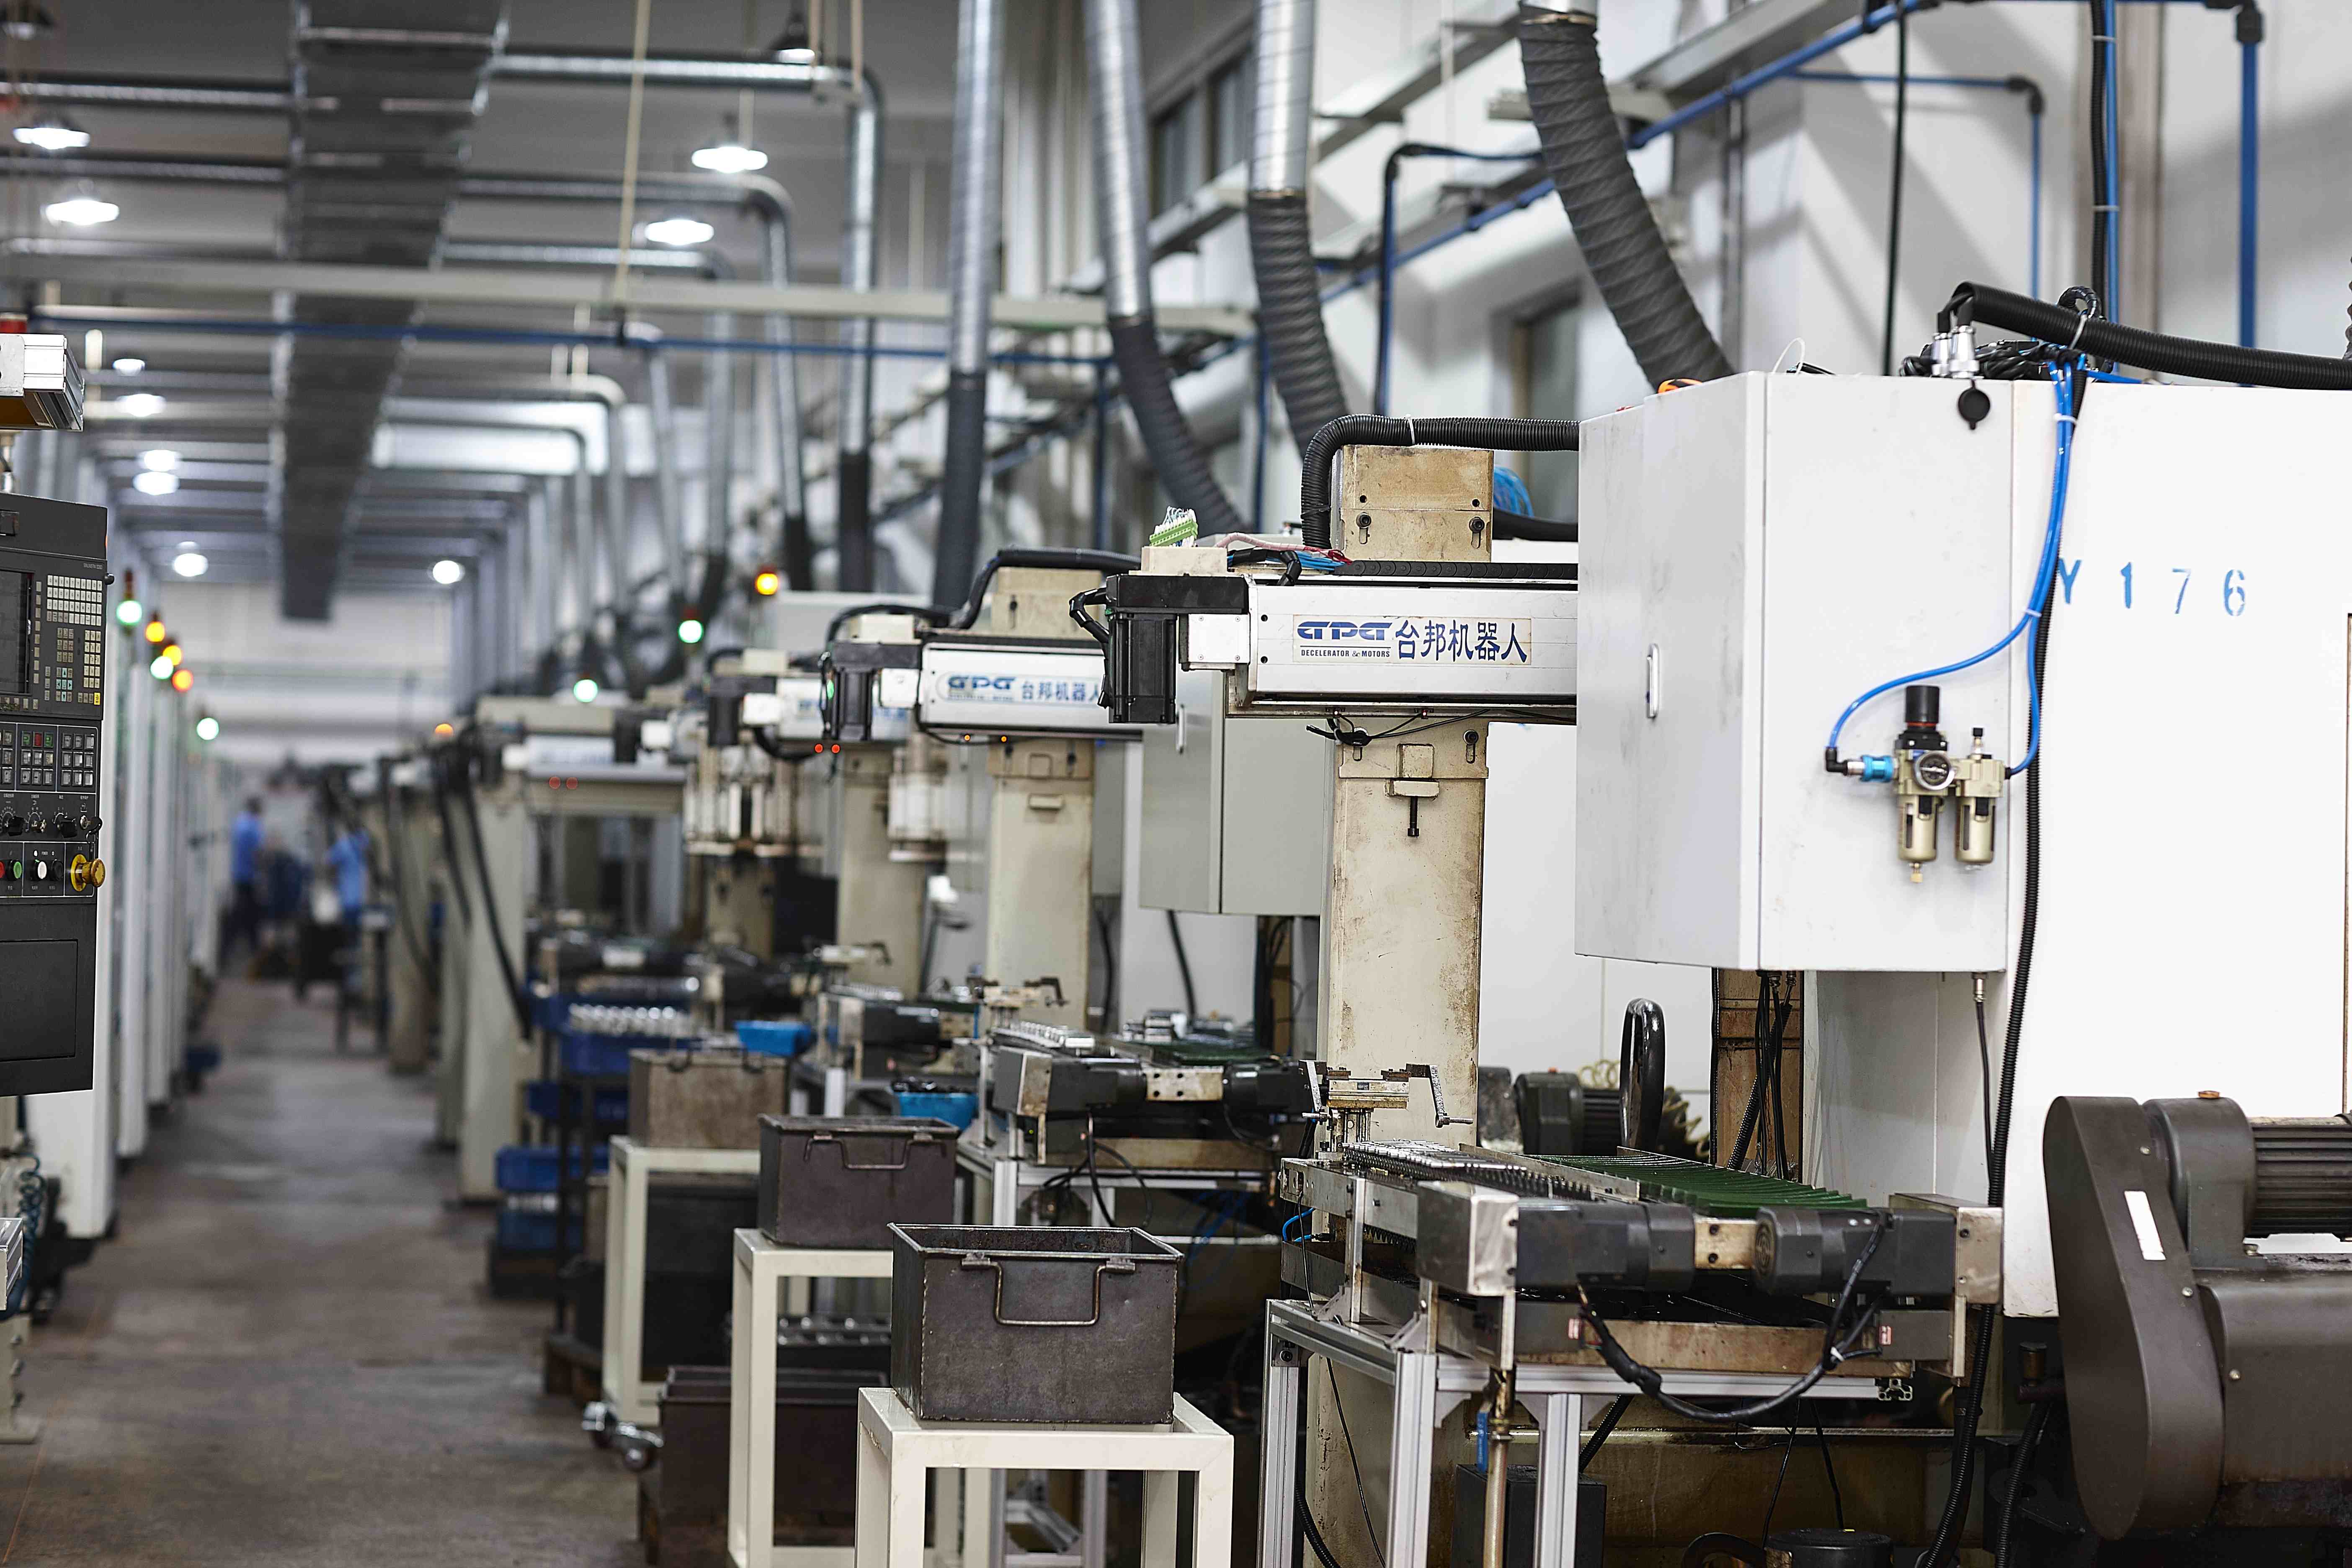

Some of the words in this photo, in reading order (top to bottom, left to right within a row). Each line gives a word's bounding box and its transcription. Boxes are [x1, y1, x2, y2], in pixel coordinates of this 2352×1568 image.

[1395, 619, 1527, 663] 台邦机器人
